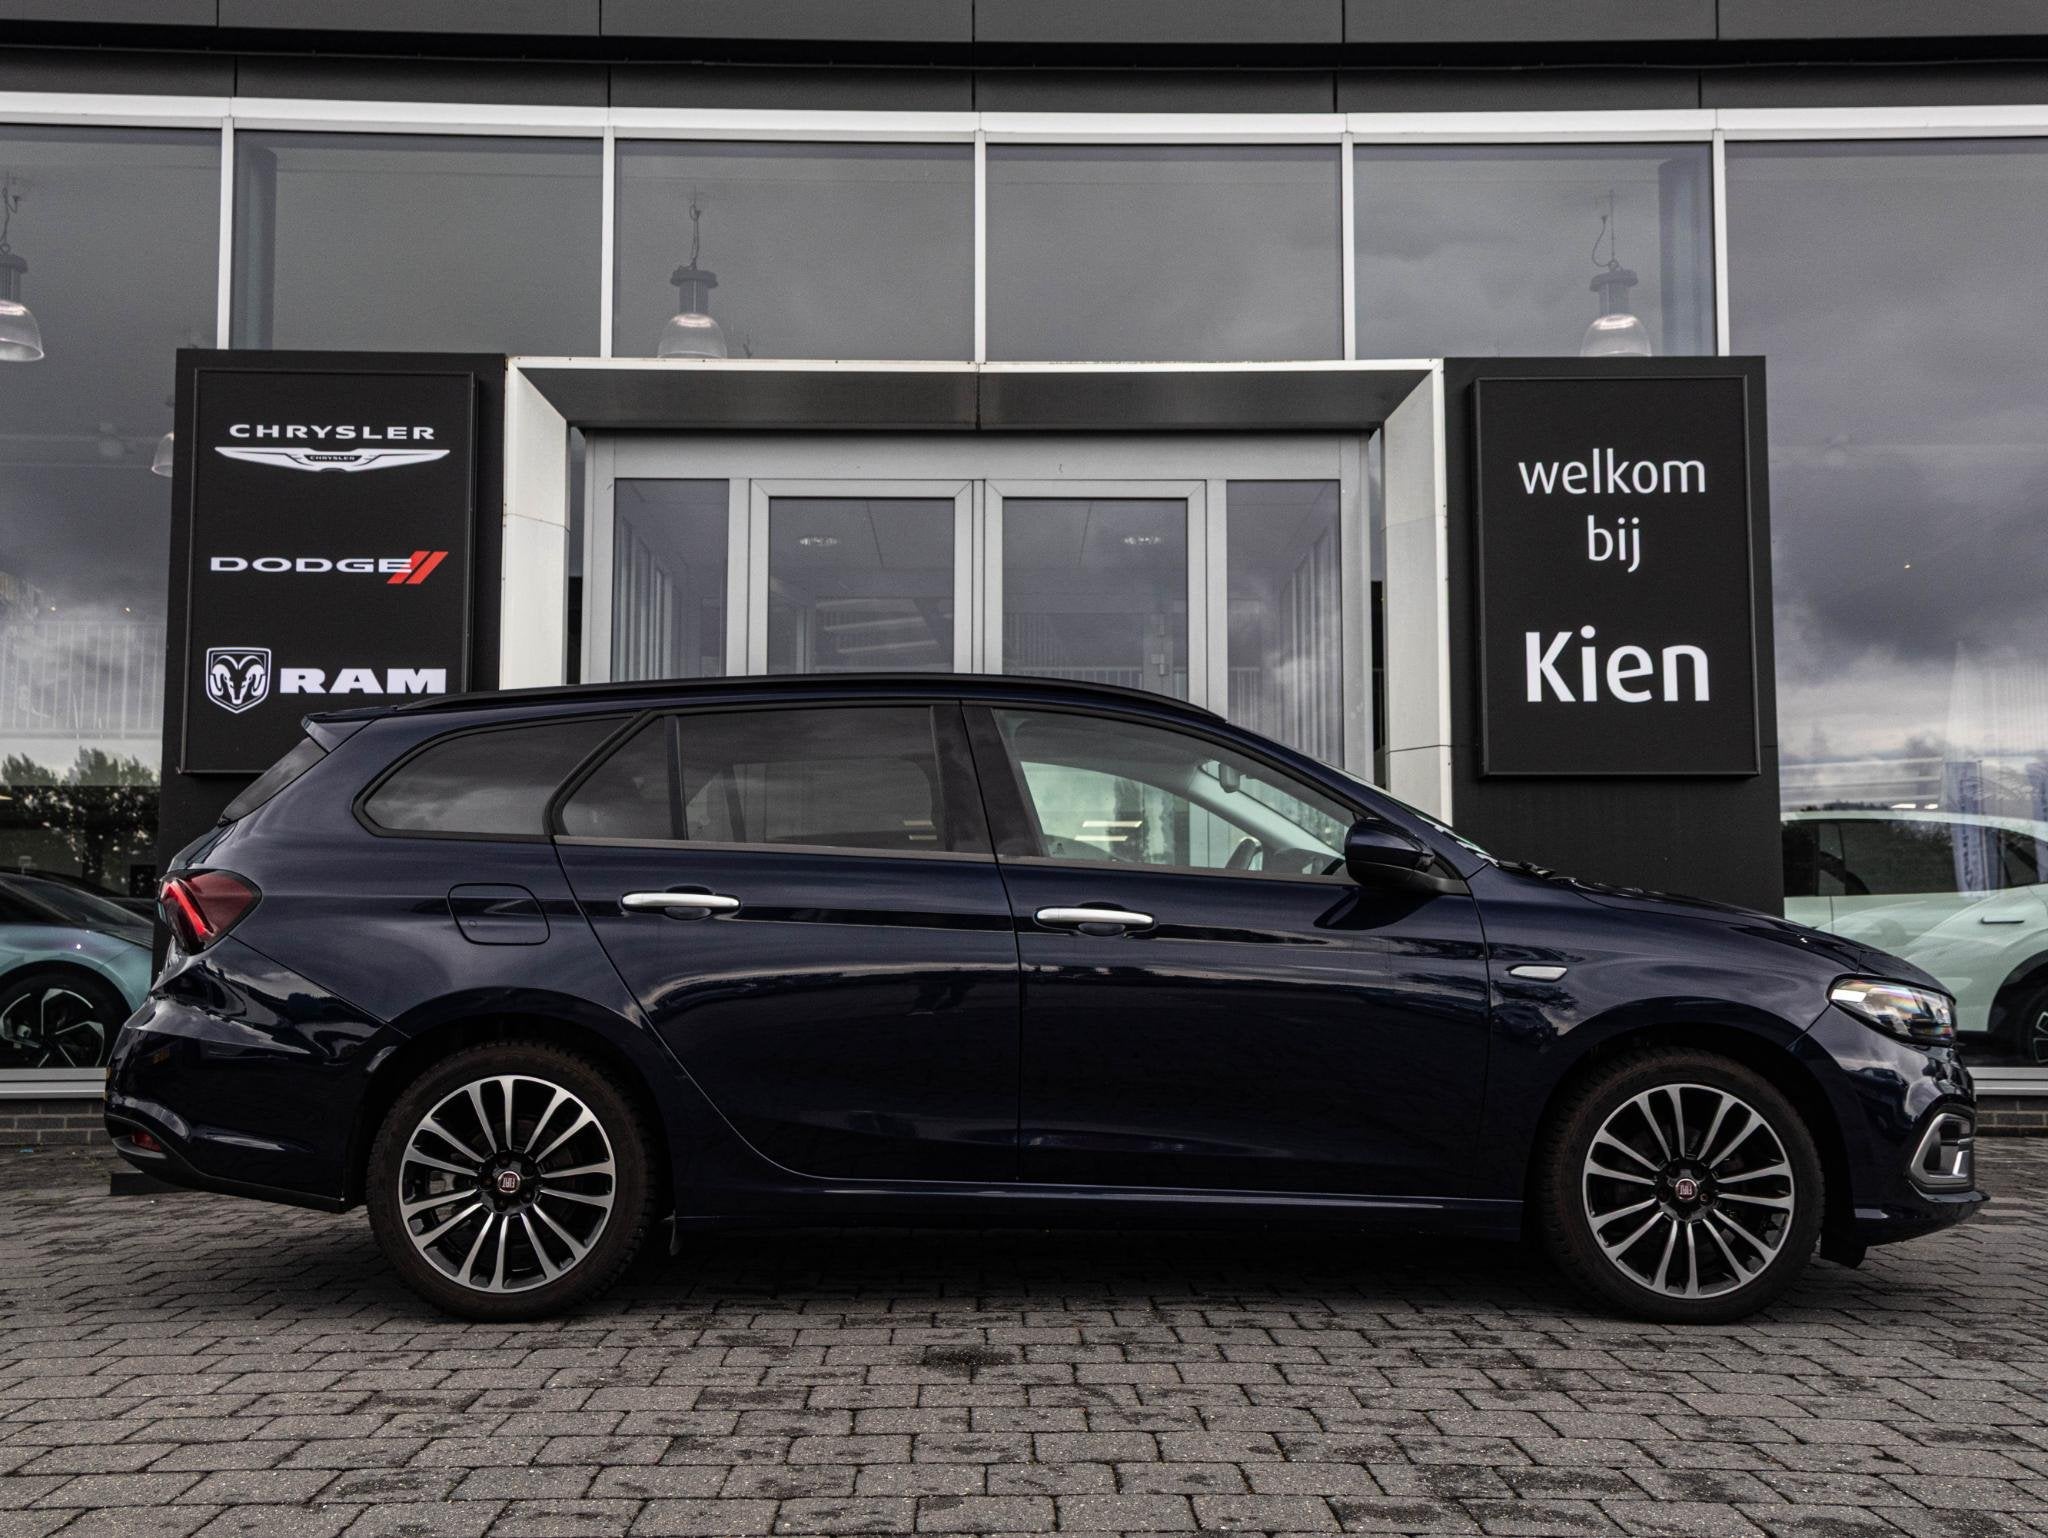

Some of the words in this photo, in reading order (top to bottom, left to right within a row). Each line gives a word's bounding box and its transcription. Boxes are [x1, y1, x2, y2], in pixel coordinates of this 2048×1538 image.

[229, 423, 435, 440] CHRYSLER
[1518, 447, 1706, 495] welkom
[1587, 514, 1641, 573] bij
[210, 556, 412, 574] DODGE
[1525, 624, 1710, 703] Kien
[279, 667, 447, 694] RAM
[502, 1177, 516, 1188] FIAT
